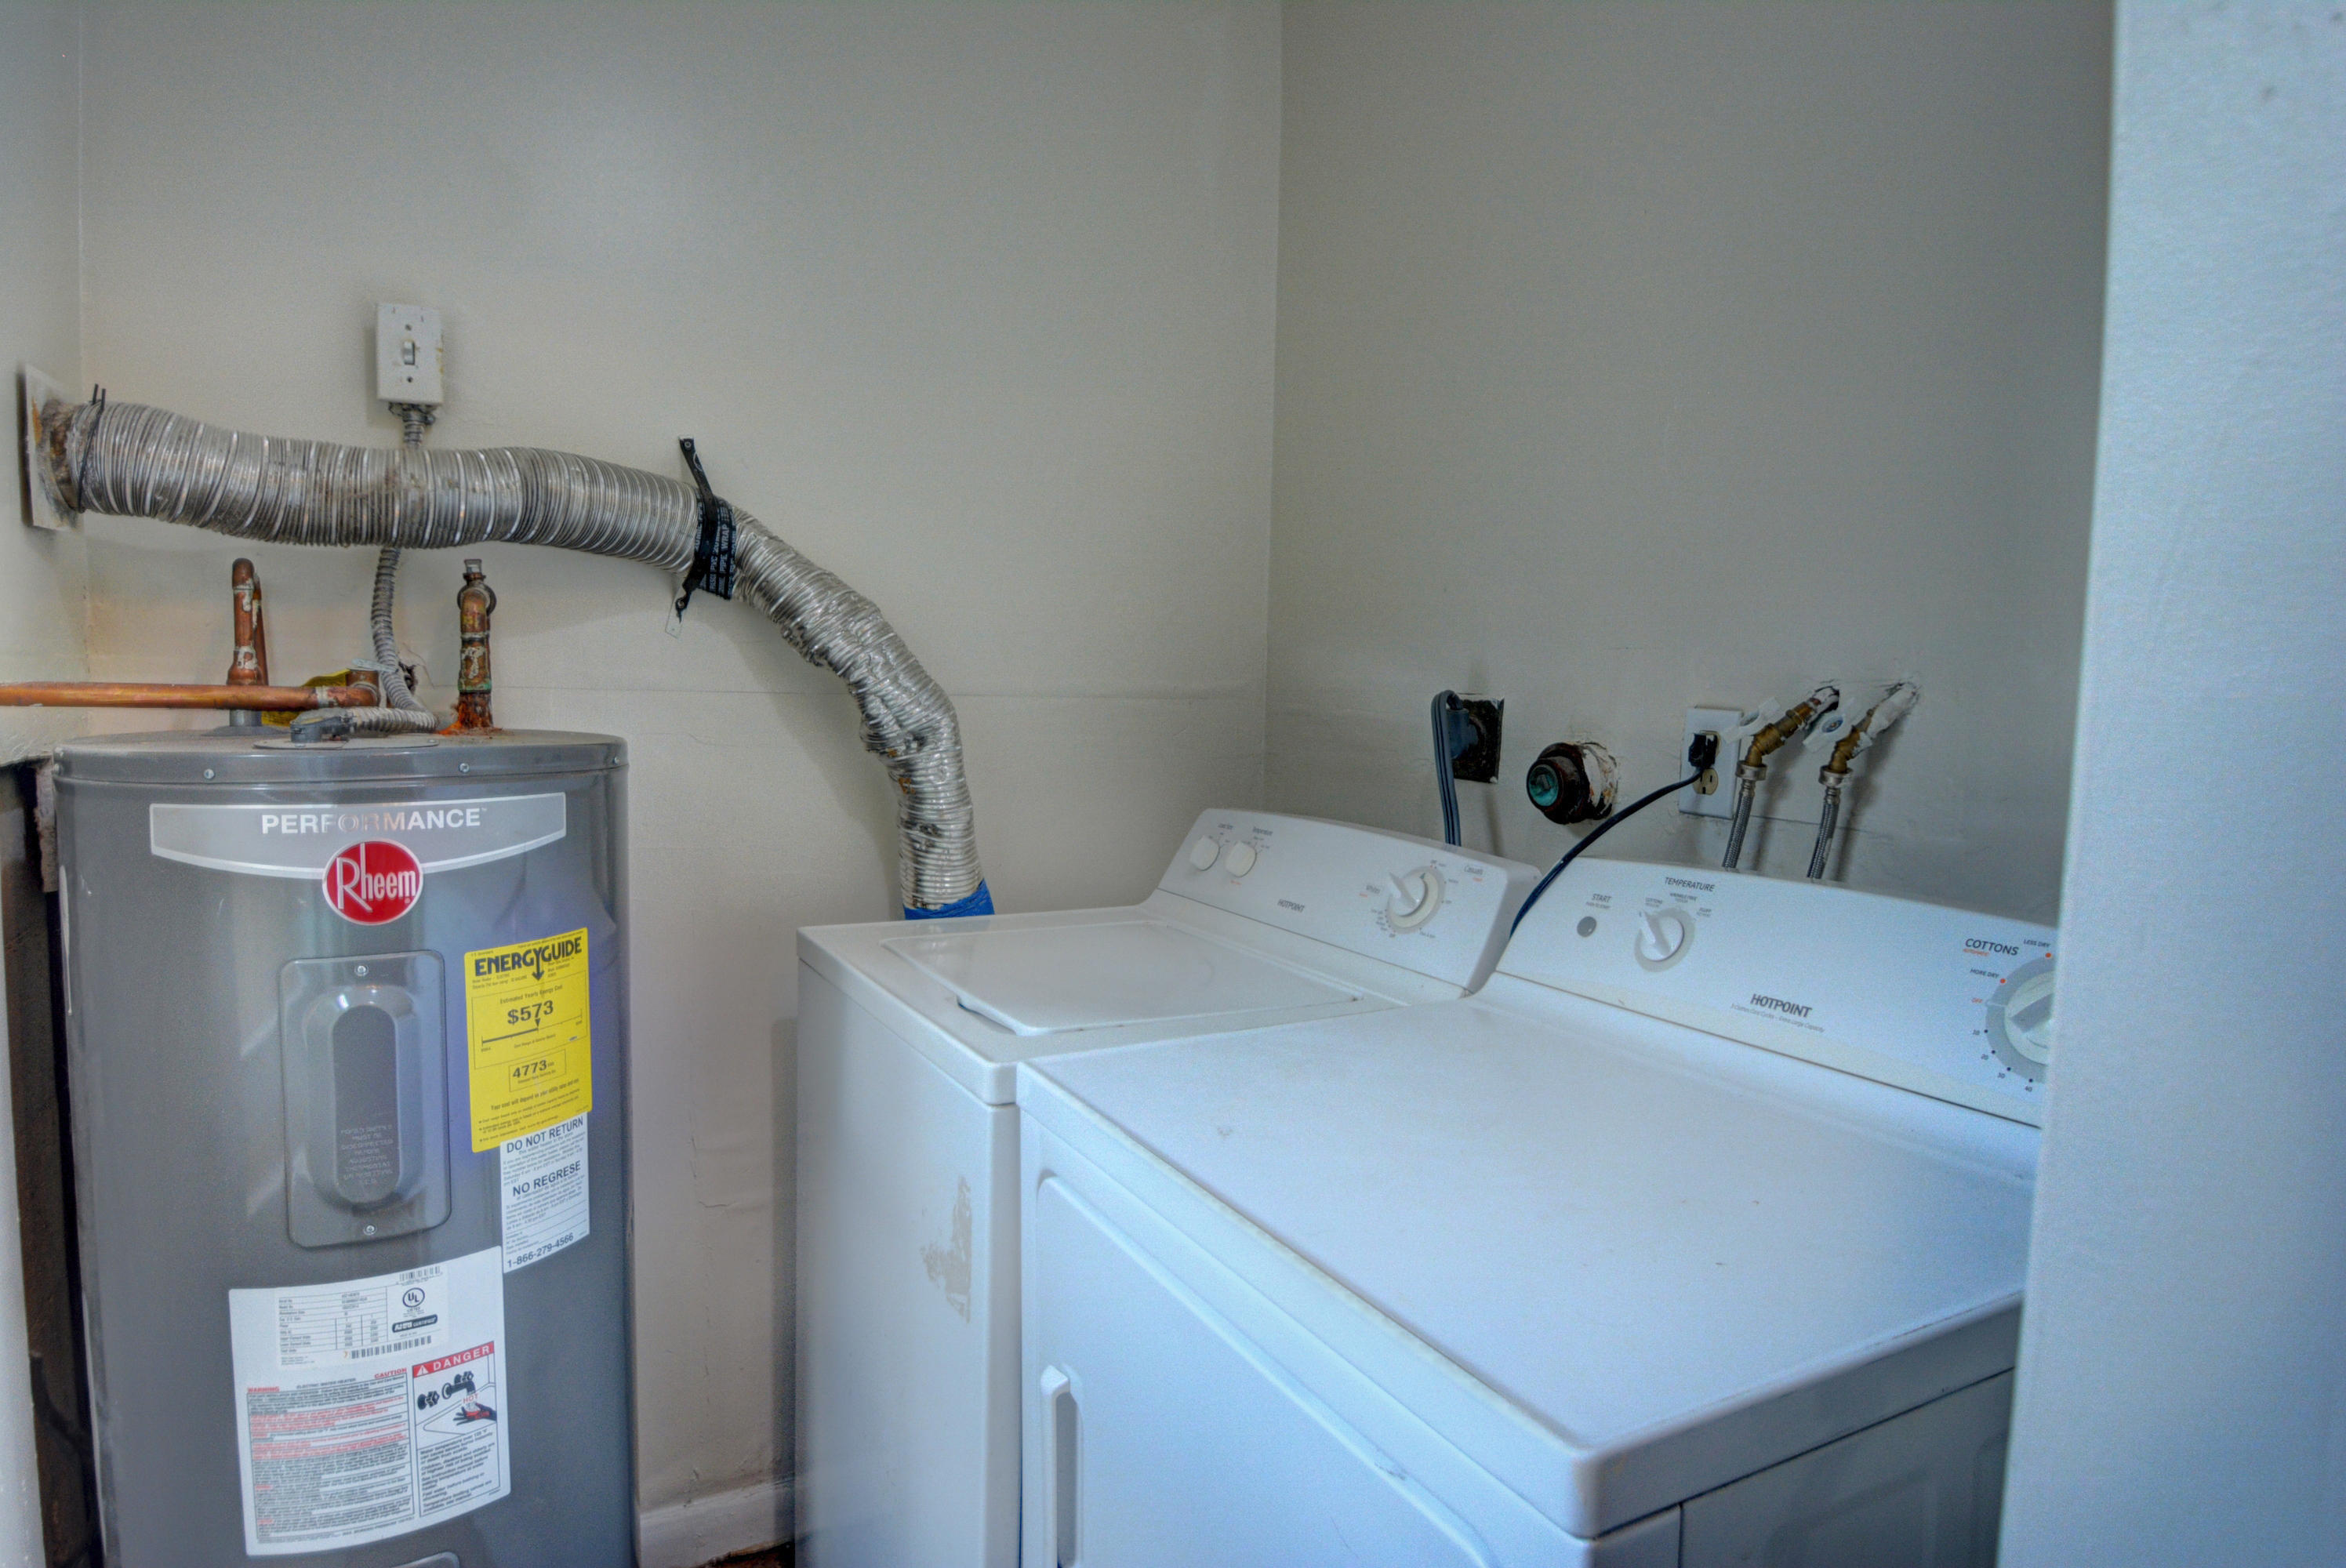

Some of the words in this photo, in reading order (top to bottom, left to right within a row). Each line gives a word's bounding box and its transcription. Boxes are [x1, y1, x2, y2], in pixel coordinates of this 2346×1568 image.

[721, 523, 729, 550] WRAP
[719, 554, 728, 572] PIPE
[262, 808, 481, 834] PERFORMANCE
[336, 842, 416, 913] Rheem
[1665, 877, 1716, 892] TEMPERATURE
[1277, 898, 1305, 913] HOTPOINT
[1592, 894, 1612, 902] START
[474, 936, 583, 978] ENERGYGUIDE
[1965, 938, 2020, 956] COTTONS
[507, 1000, 554, 1025] $573
[1750, 993, 1813, 1018] HOTPOINT
[513, 1060, 547, 1079] 4773
[507, 1139, 523, 1153] DO
[526, 1131, 547, 1147] NOT
[549, 1116, 583, 1139] RETURN
[513, 1181, 530, 1196] NO
[534, 1160, 581, 1189] REGRESE
[507, 1232, 574, 1267] 1-866-279-4566
[408, 1291, 420, 1303] UL
[434, 1345, 490, 1370] DANGER
[374, 1368, 407, 1379] CAUTION
[463, 1393, 479, 1404] HOT
